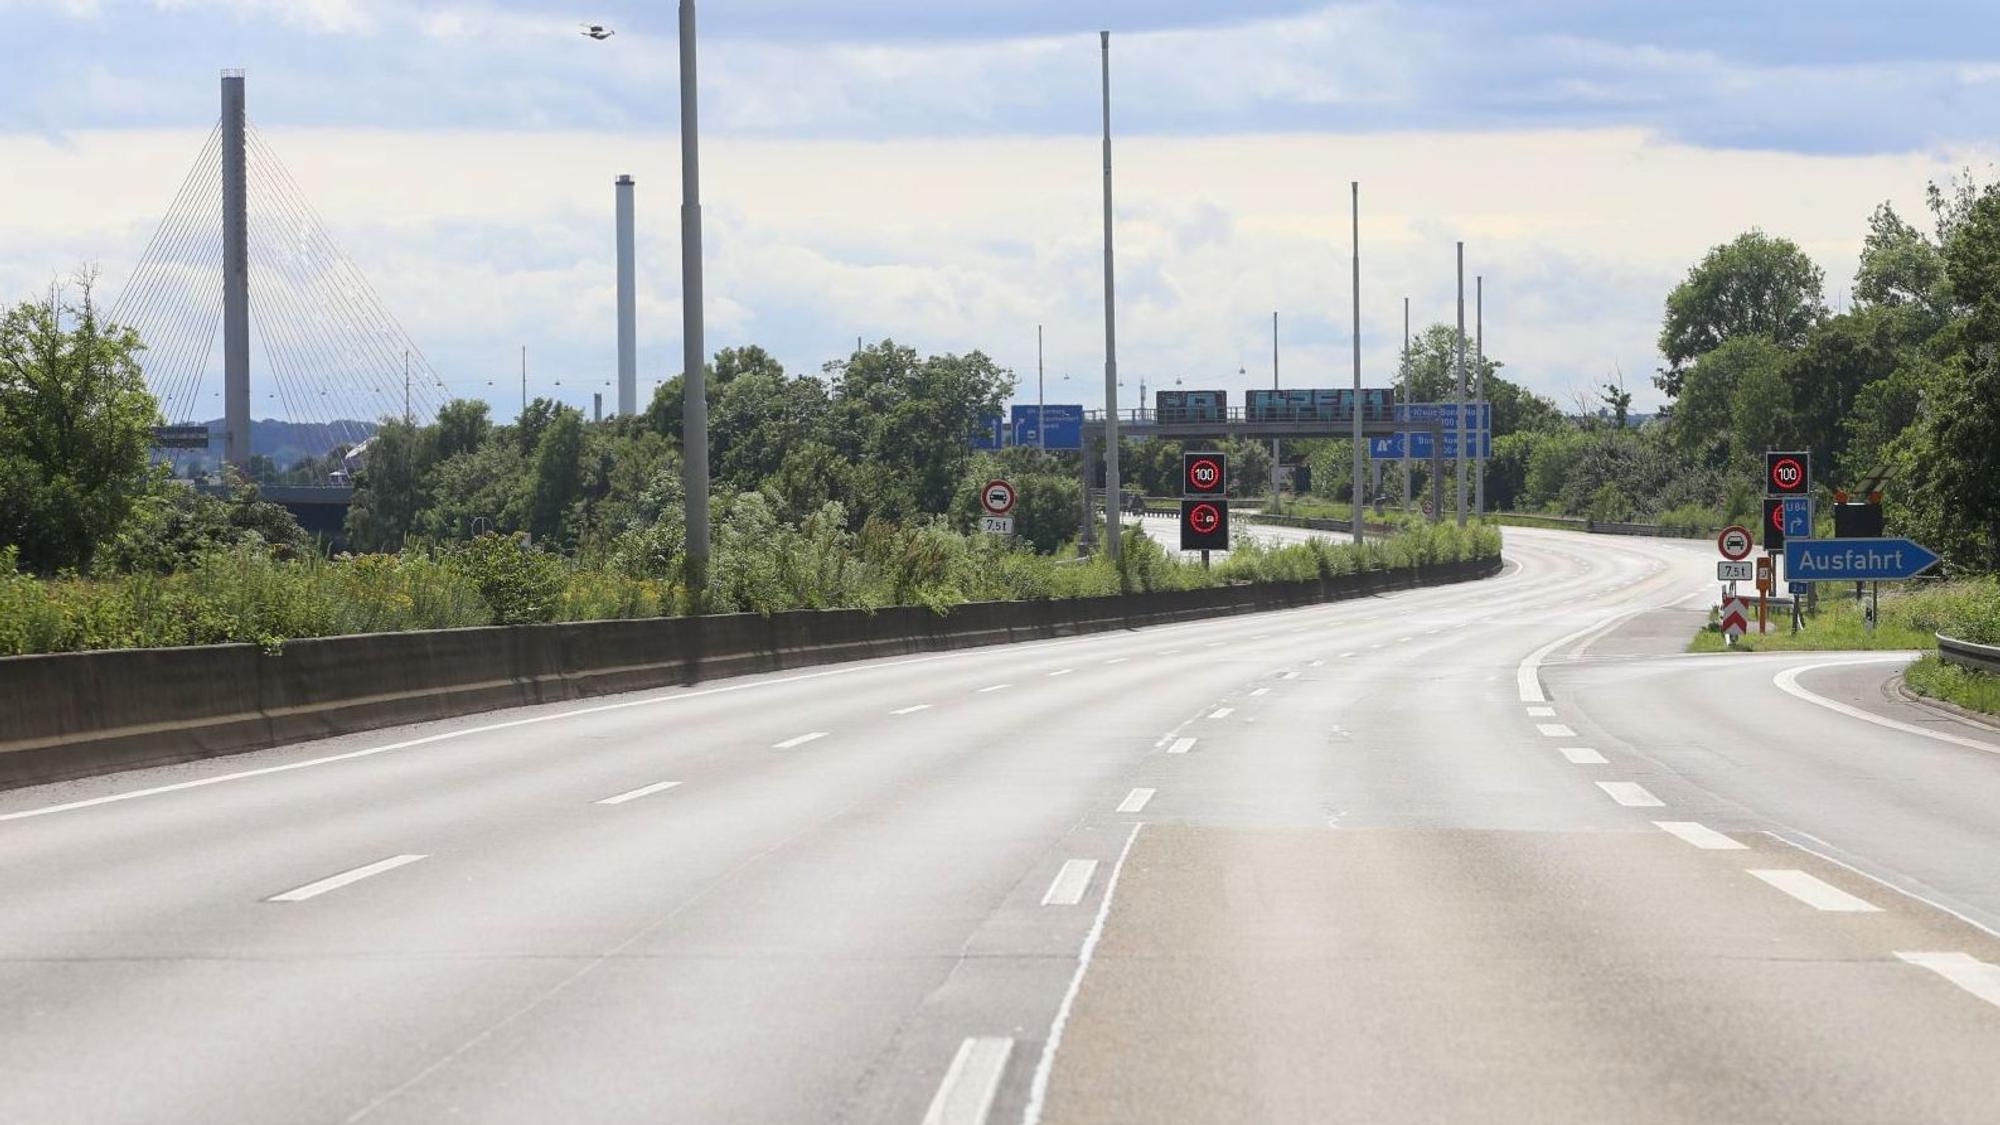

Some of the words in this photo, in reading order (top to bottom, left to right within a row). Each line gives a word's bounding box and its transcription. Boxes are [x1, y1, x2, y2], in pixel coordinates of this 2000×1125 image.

[1195, 468, 1214, 481] 100
[1778, 467, 1797, 481] 100
[1786, 502, 1807, 512] U84
[1799, 549, 1903, 571] Ausfahrt
